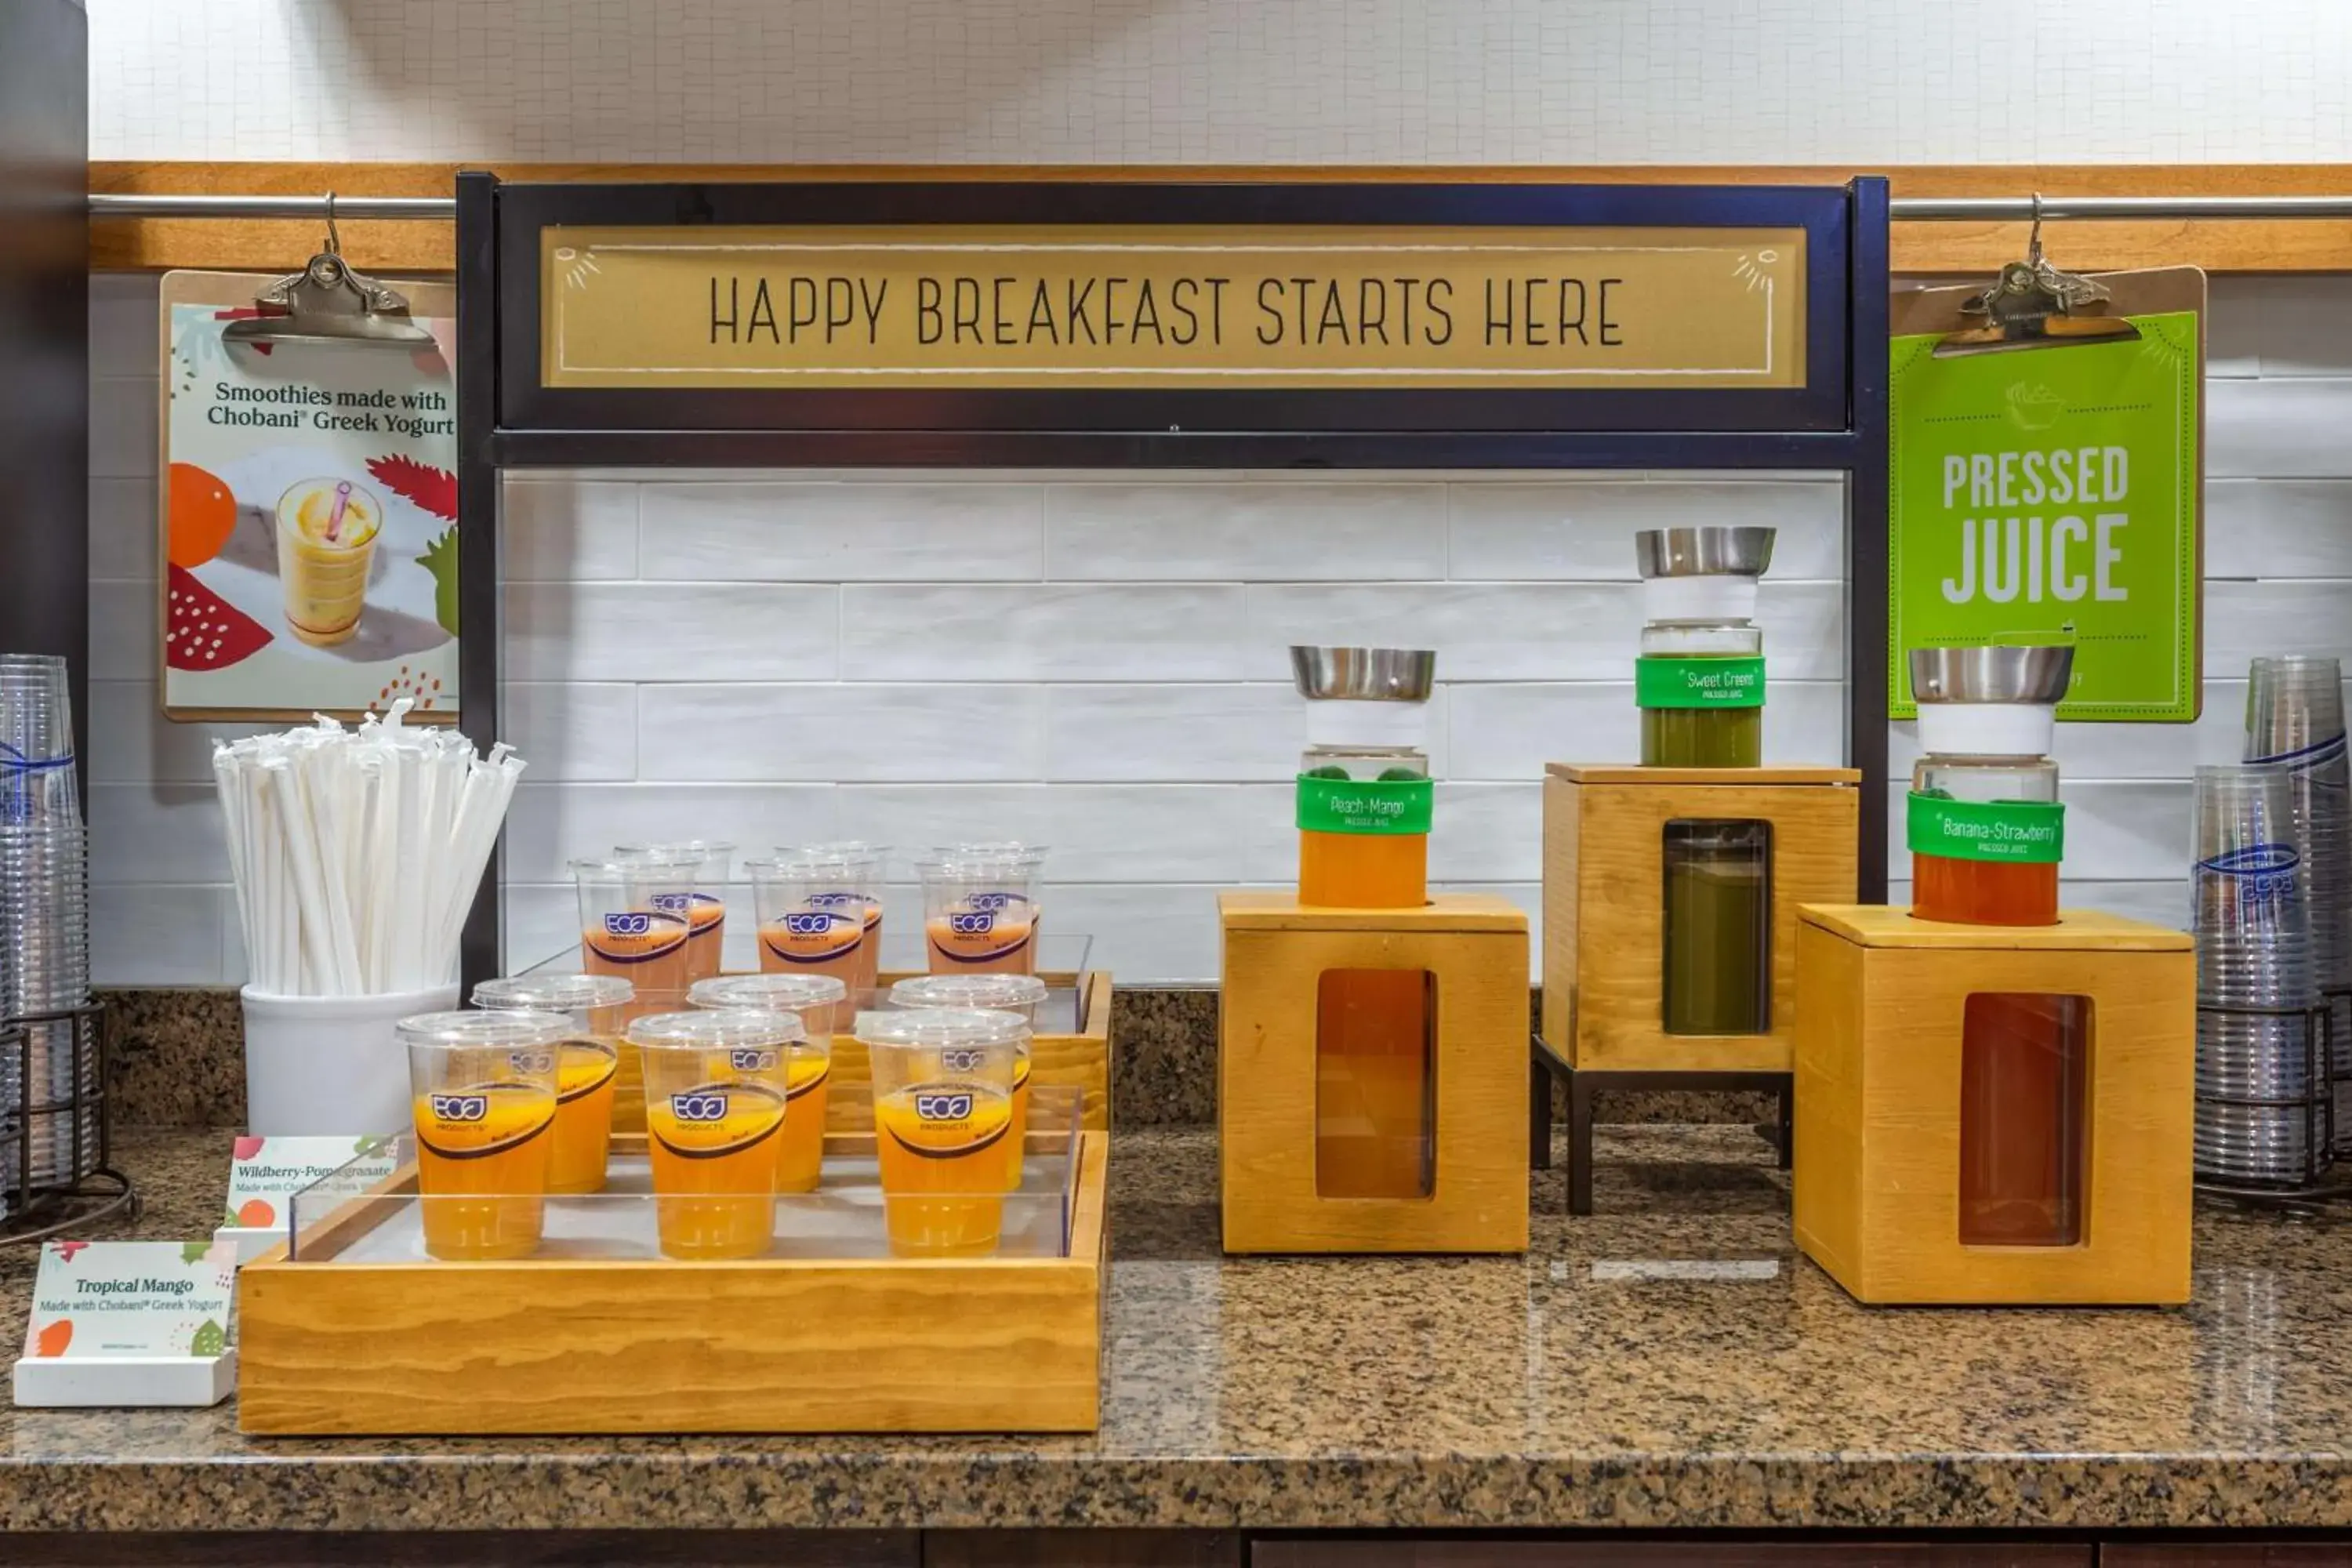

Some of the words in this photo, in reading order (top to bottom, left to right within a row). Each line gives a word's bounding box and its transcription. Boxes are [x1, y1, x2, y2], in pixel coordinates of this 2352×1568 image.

[710, 277, 887, 343] HAPPY
[917, 278, 1231, 344] BREAKFAST
[1256, 278, 1454, 345] STARTS
[1486, 278, 1624, 346] HERE
[216, 383, 332, 405] Smoothies
[337, 389, 397, 408] made
[401, 392, 446, 411] with
[314, 410, 380, 432] Greek
[385, 414, 455, 437] Yogurt
[1943, 446, 2129, 509] PRESSED
[1941, 514, 2129, 604] JUICE
[1687, 671, 1721, 688] Sweet
[1330, 795, 1405, 818] Peach-Mango
[76, 1278, 139, 1296] Tropical
[141, 1279, 194, 1296] Mango
[39, 1299, 71, 1312] Made
[72, 1300, 96, 1312] with
[151, 1299, 184, 1311] Greek
[187, 1299, 223, 1312] Yogurt
